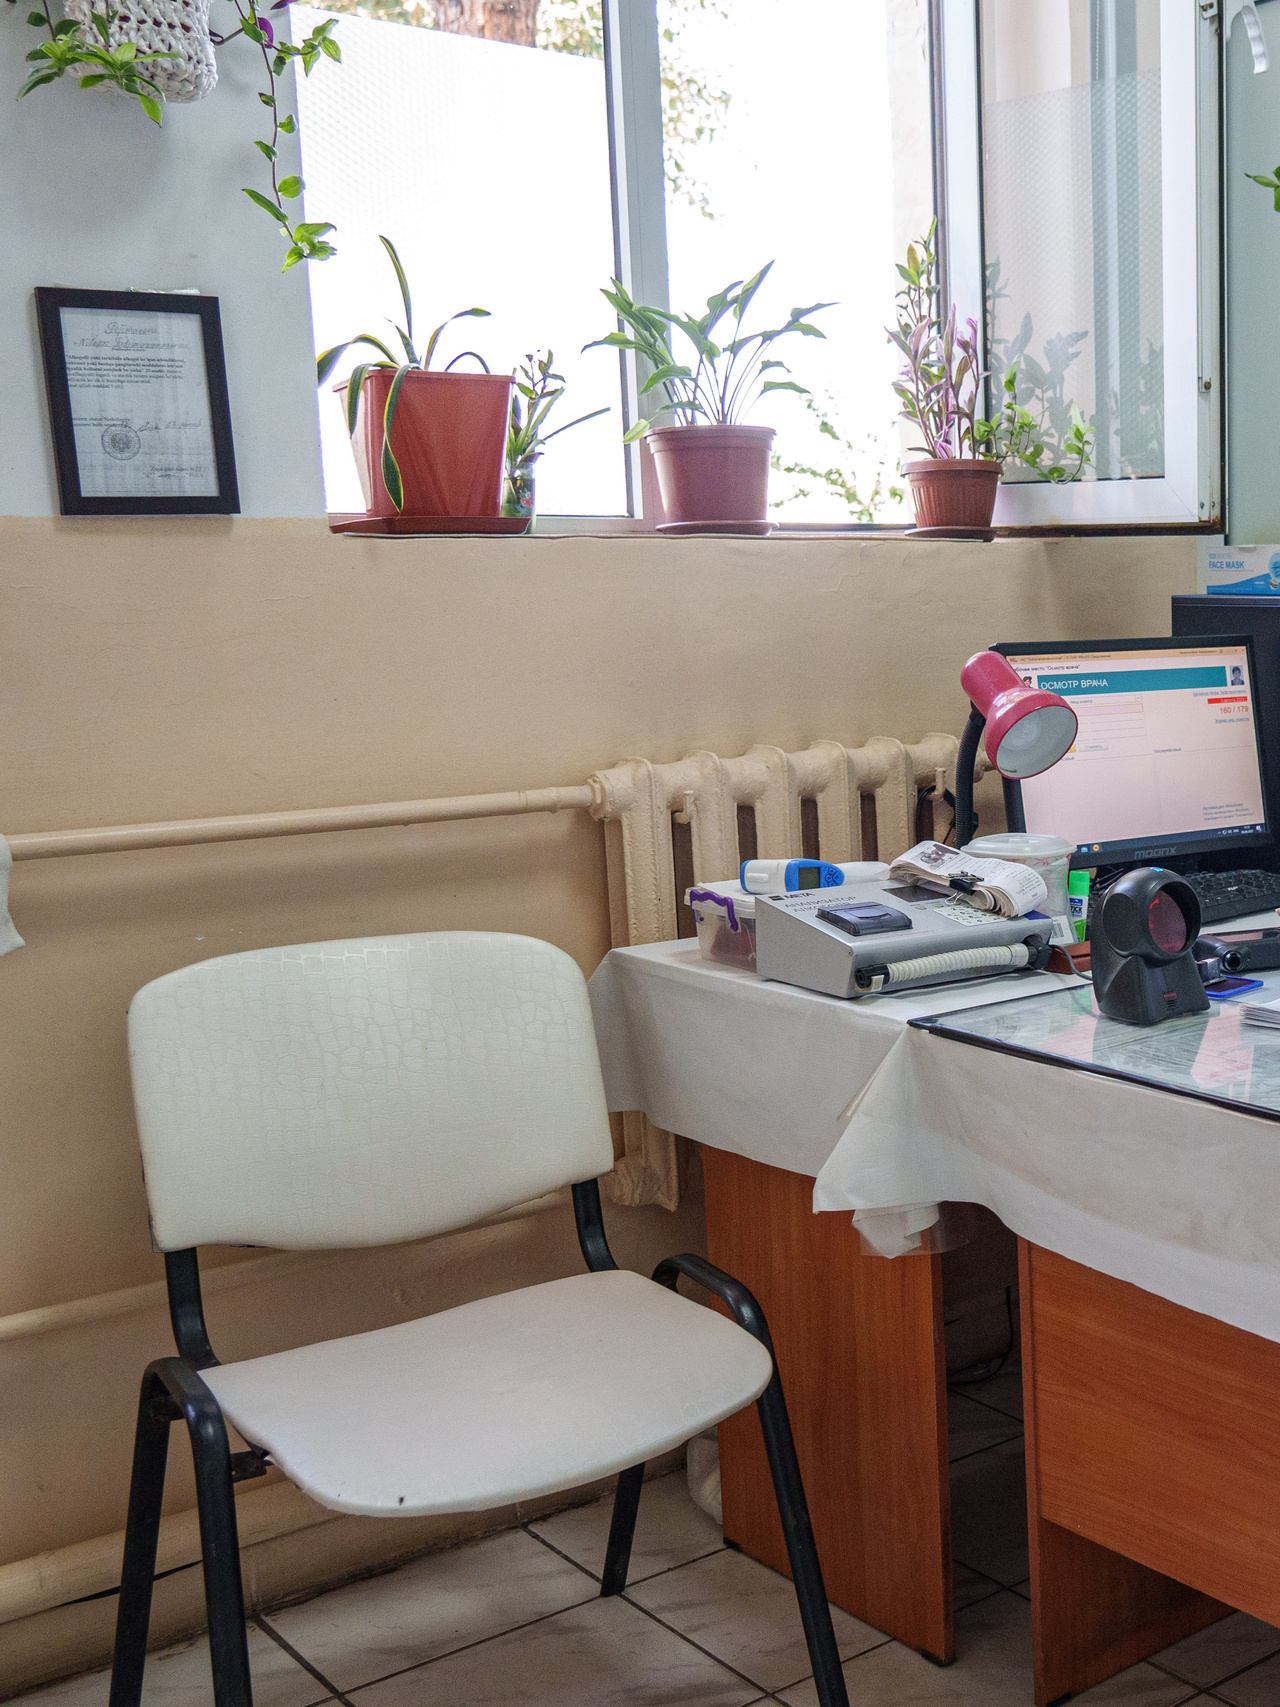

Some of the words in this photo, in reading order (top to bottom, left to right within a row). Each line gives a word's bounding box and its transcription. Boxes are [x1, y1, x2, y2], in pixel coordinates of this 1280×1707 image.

[1208, 561, 1224, 569] FACE
[1225, 561, 1245, 569] MASK
[1040, 680, 1079, 690] ОСМОТР
[1080, 678, 1109, 688] ВРАЧА
[1237, 705, 1249, 713] 179
